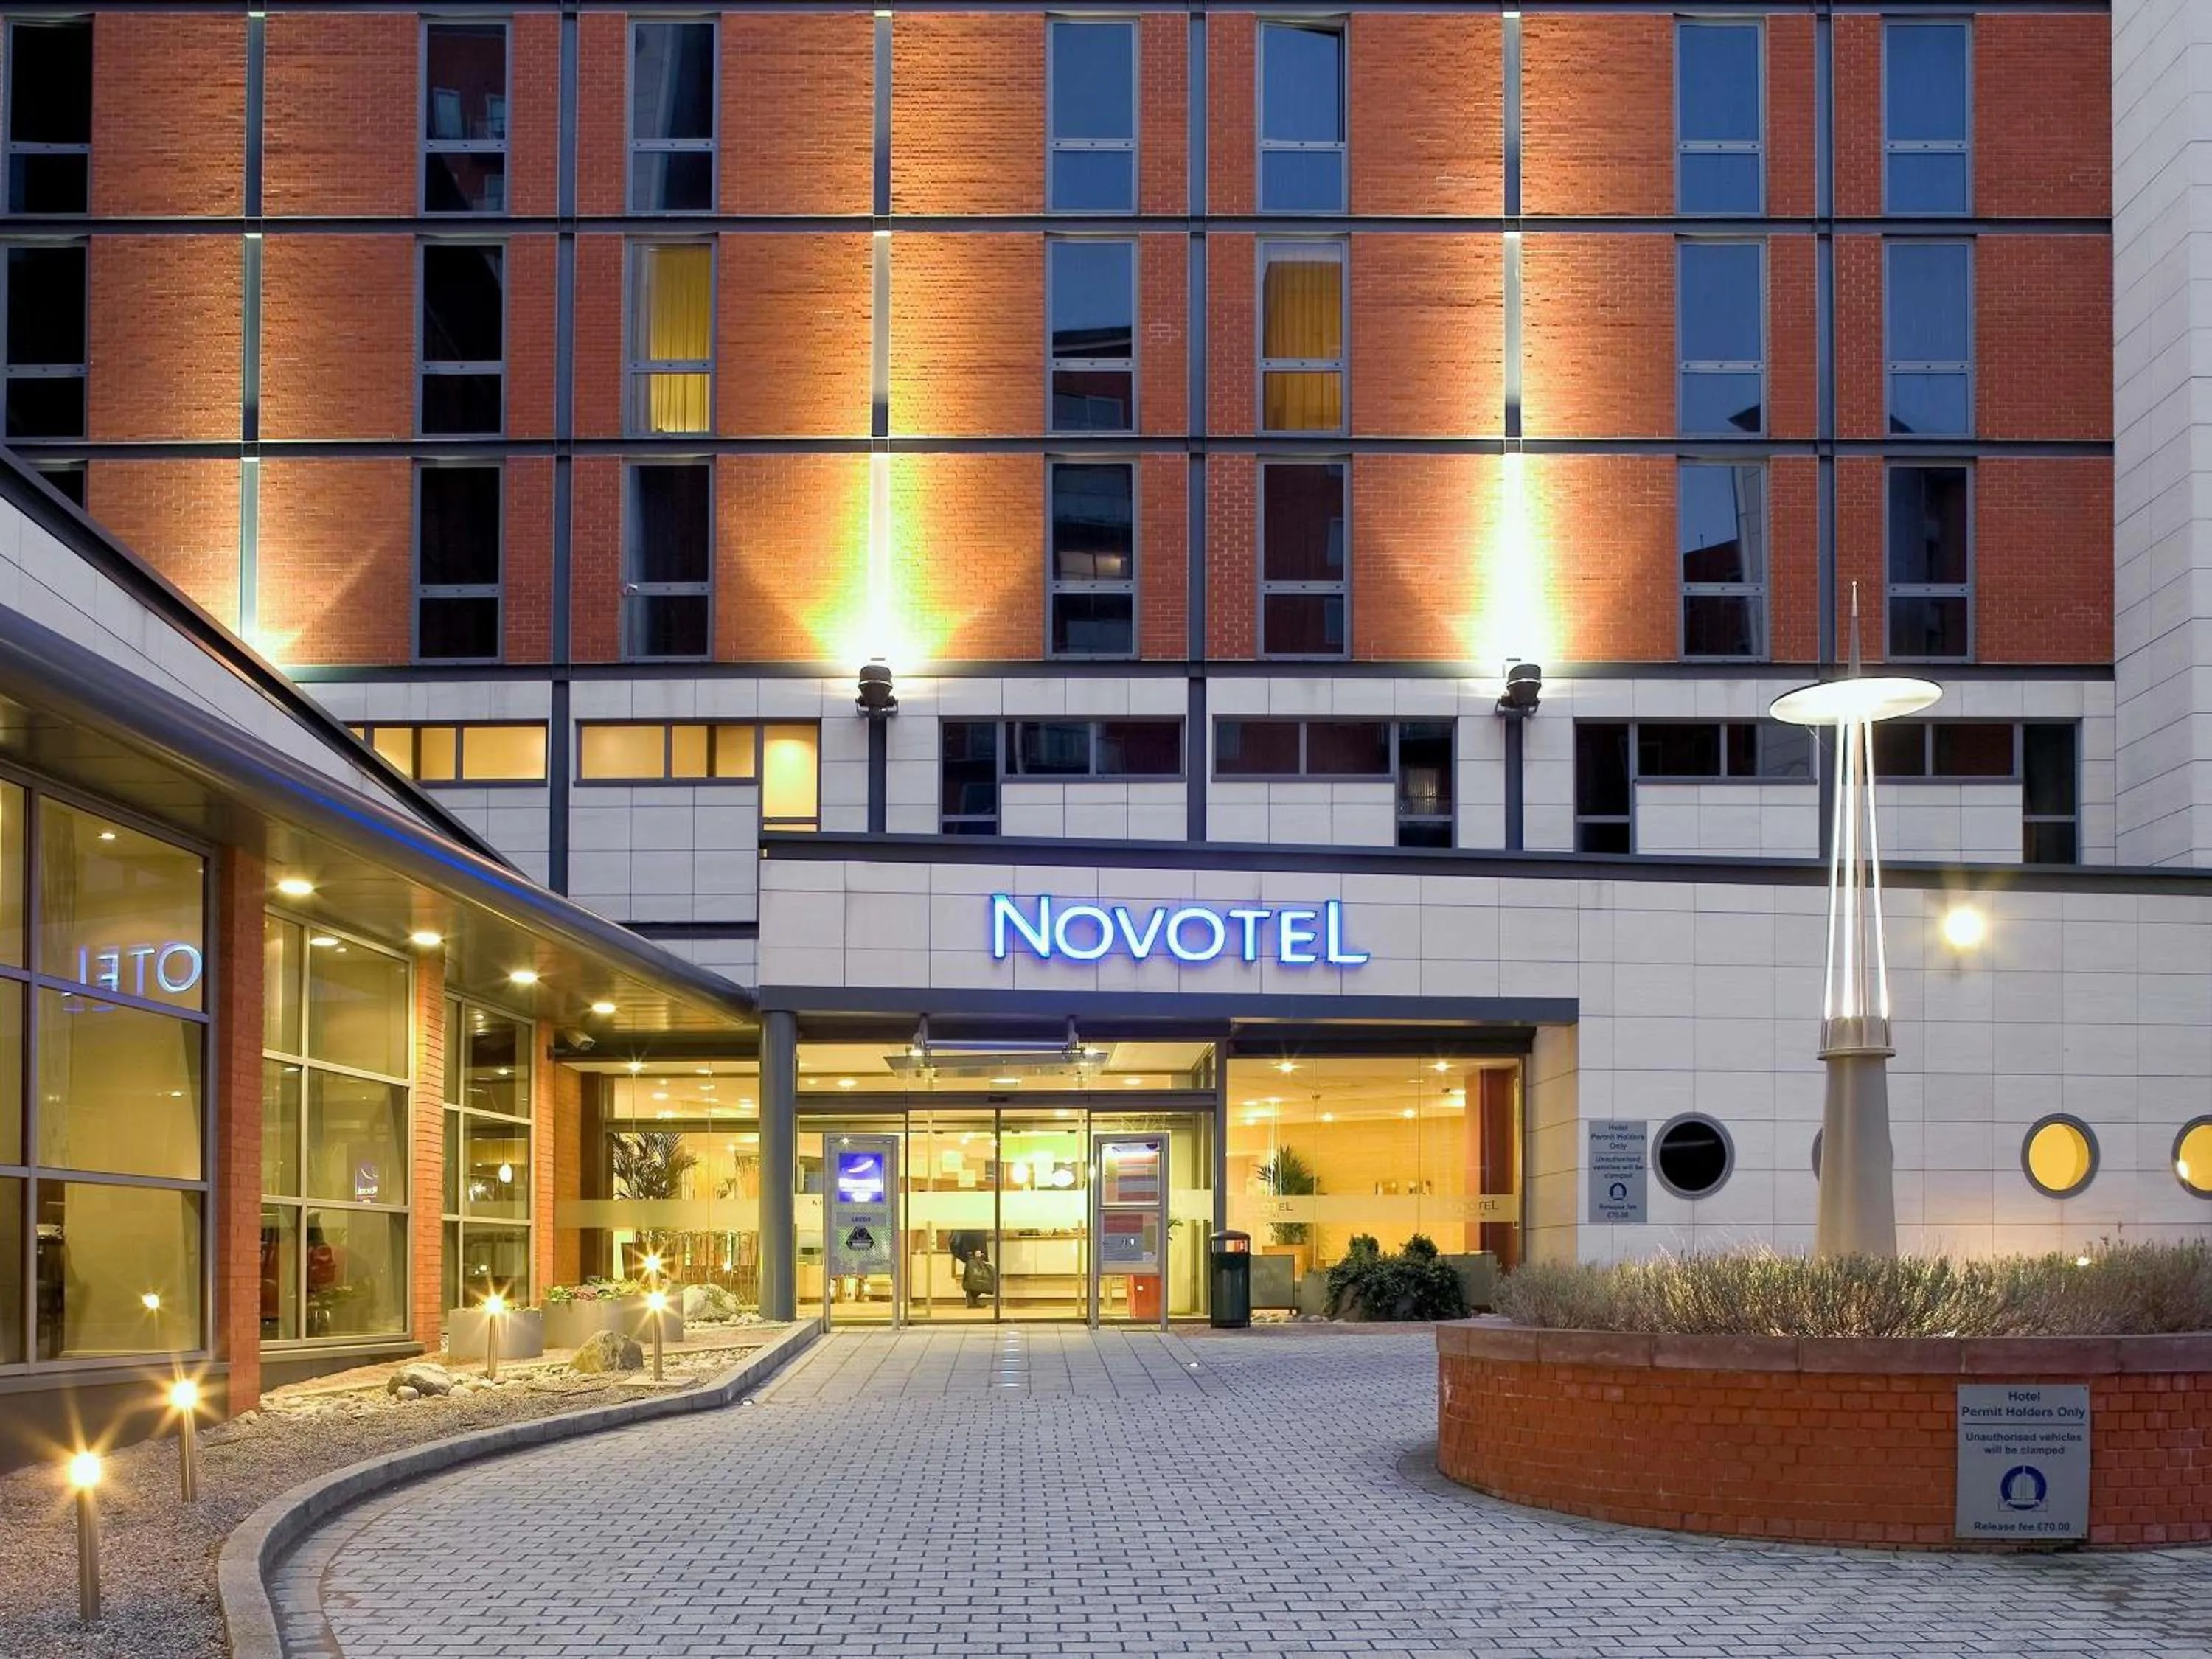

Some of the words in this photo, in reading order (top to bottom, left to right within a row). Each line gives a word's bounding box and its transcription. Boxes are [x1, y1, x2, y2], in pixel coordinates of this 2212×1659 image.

[992, 894, 1370, 964] NOVOTEL
[2008, 1391, 2040, 1402] Hotel
[1961, 1406, 2002, 1417] Permit
[2006, 1406, 2053, 1417] Holders
[2057, 1406, 2086, 1419] Only
[1965, 1433, 2037, 1442] Unauthorised
[2040, 1433, 2082, 1442] vehicles
[1983, 1445, 2002, 1455] will
[2005, 1445, 2017, 1455] be
[2020, 1446, 2065, 1455] clamped
[1974, 1521, 2014, 1531] Release
[2019, 1521, 2034, 1531] fee
